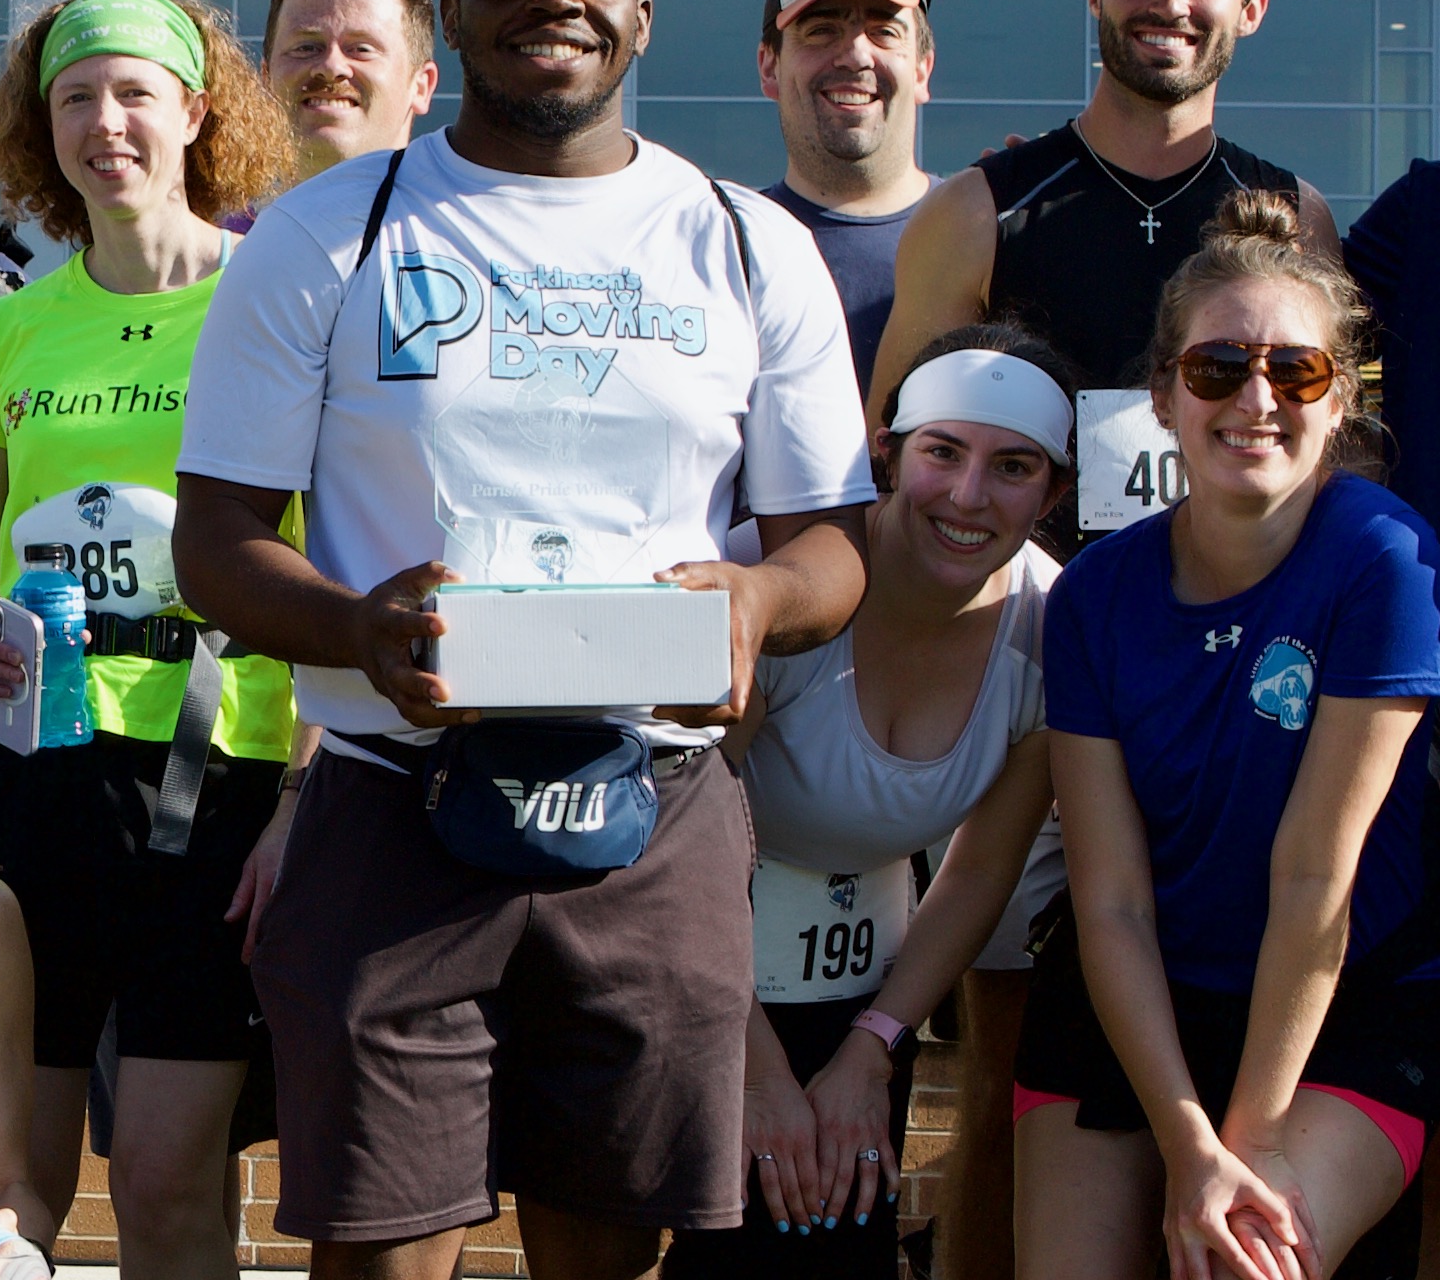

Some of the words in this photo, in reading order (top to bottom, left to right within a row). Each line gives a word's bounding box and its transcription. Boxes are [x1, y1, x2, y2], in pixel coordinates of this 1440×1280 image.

[491, 260, 641, 291] Parkinson's
[491, 285, 707, 357] Moving
[490, 331, 618, 397] Day
[4, 384, 188, 436] #RunThis
[471, 483, 522, 498] Parish
[528, 483, 572, 497] Pride
[574, 483, 637, 497] Winner
[1250, 654, 1264, 679] Little
[1281, 635, 1290, 645] of
[1291, 638, 1306, 651] the
[493, 778, 608, 833] VOLO
[798, 918, 875, 982] 199
